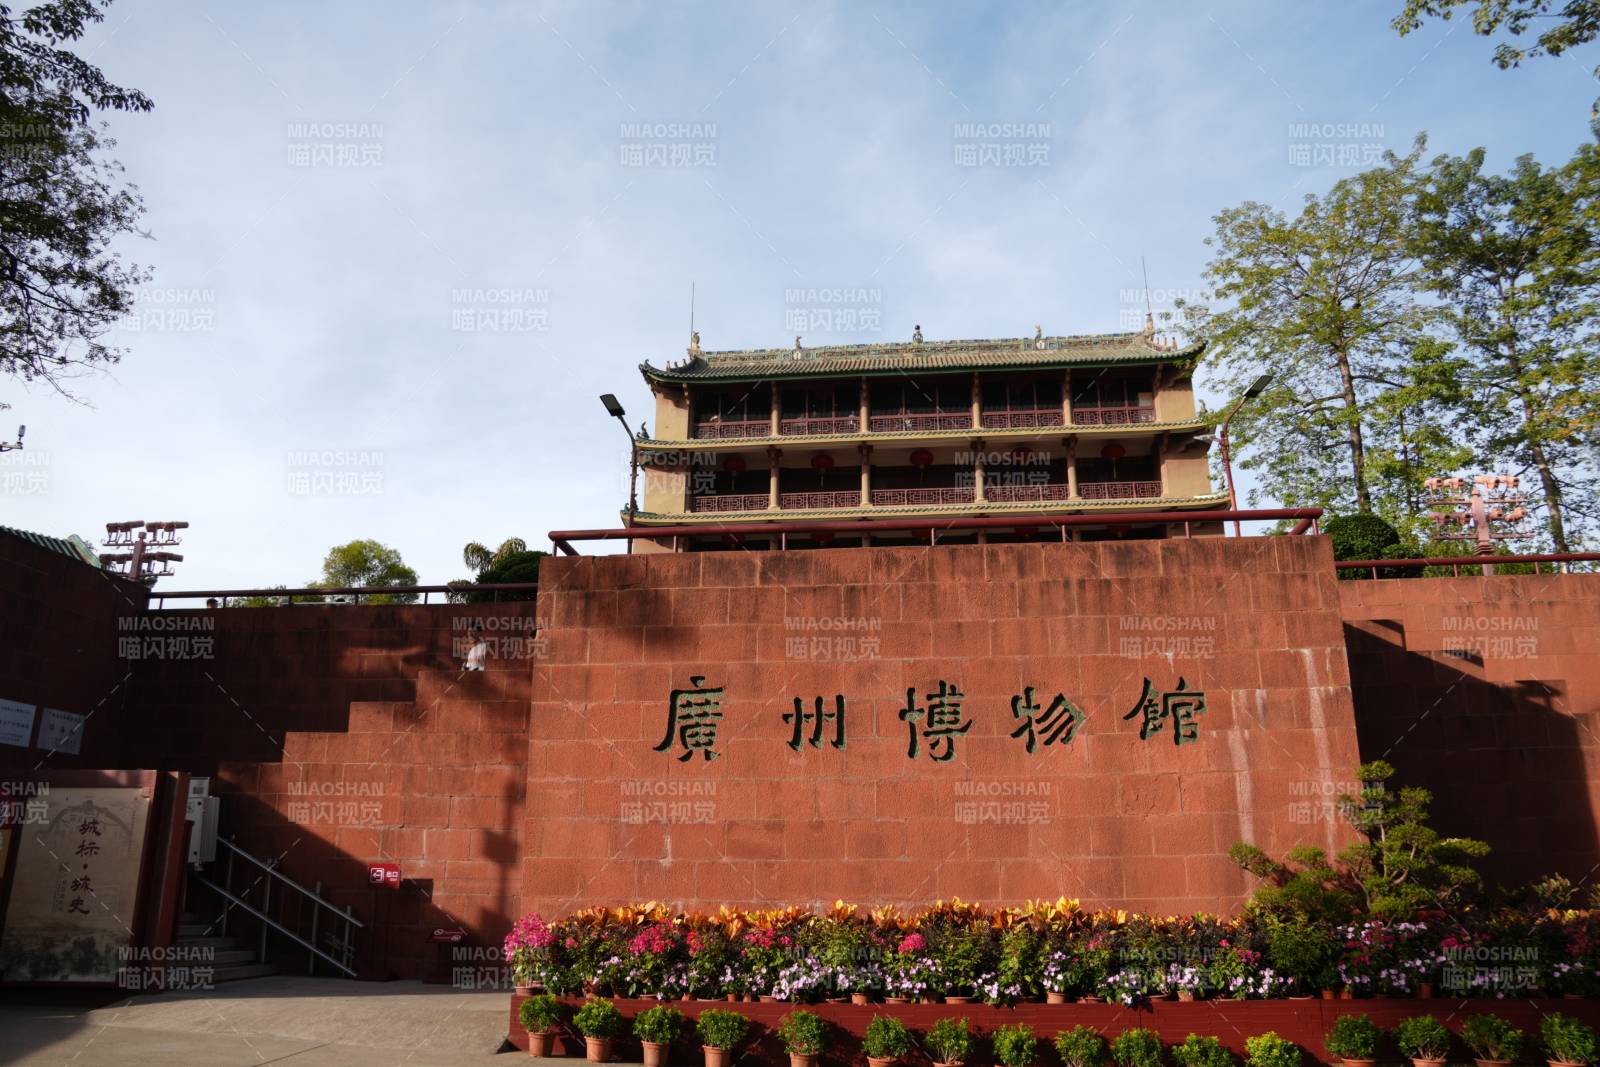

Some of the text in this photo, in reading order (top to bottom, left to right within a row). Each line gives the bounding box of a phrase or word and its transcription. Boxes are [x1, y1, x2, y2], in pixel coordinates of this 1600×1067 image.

[652, 676, 1206, 762] 廣州博物館
